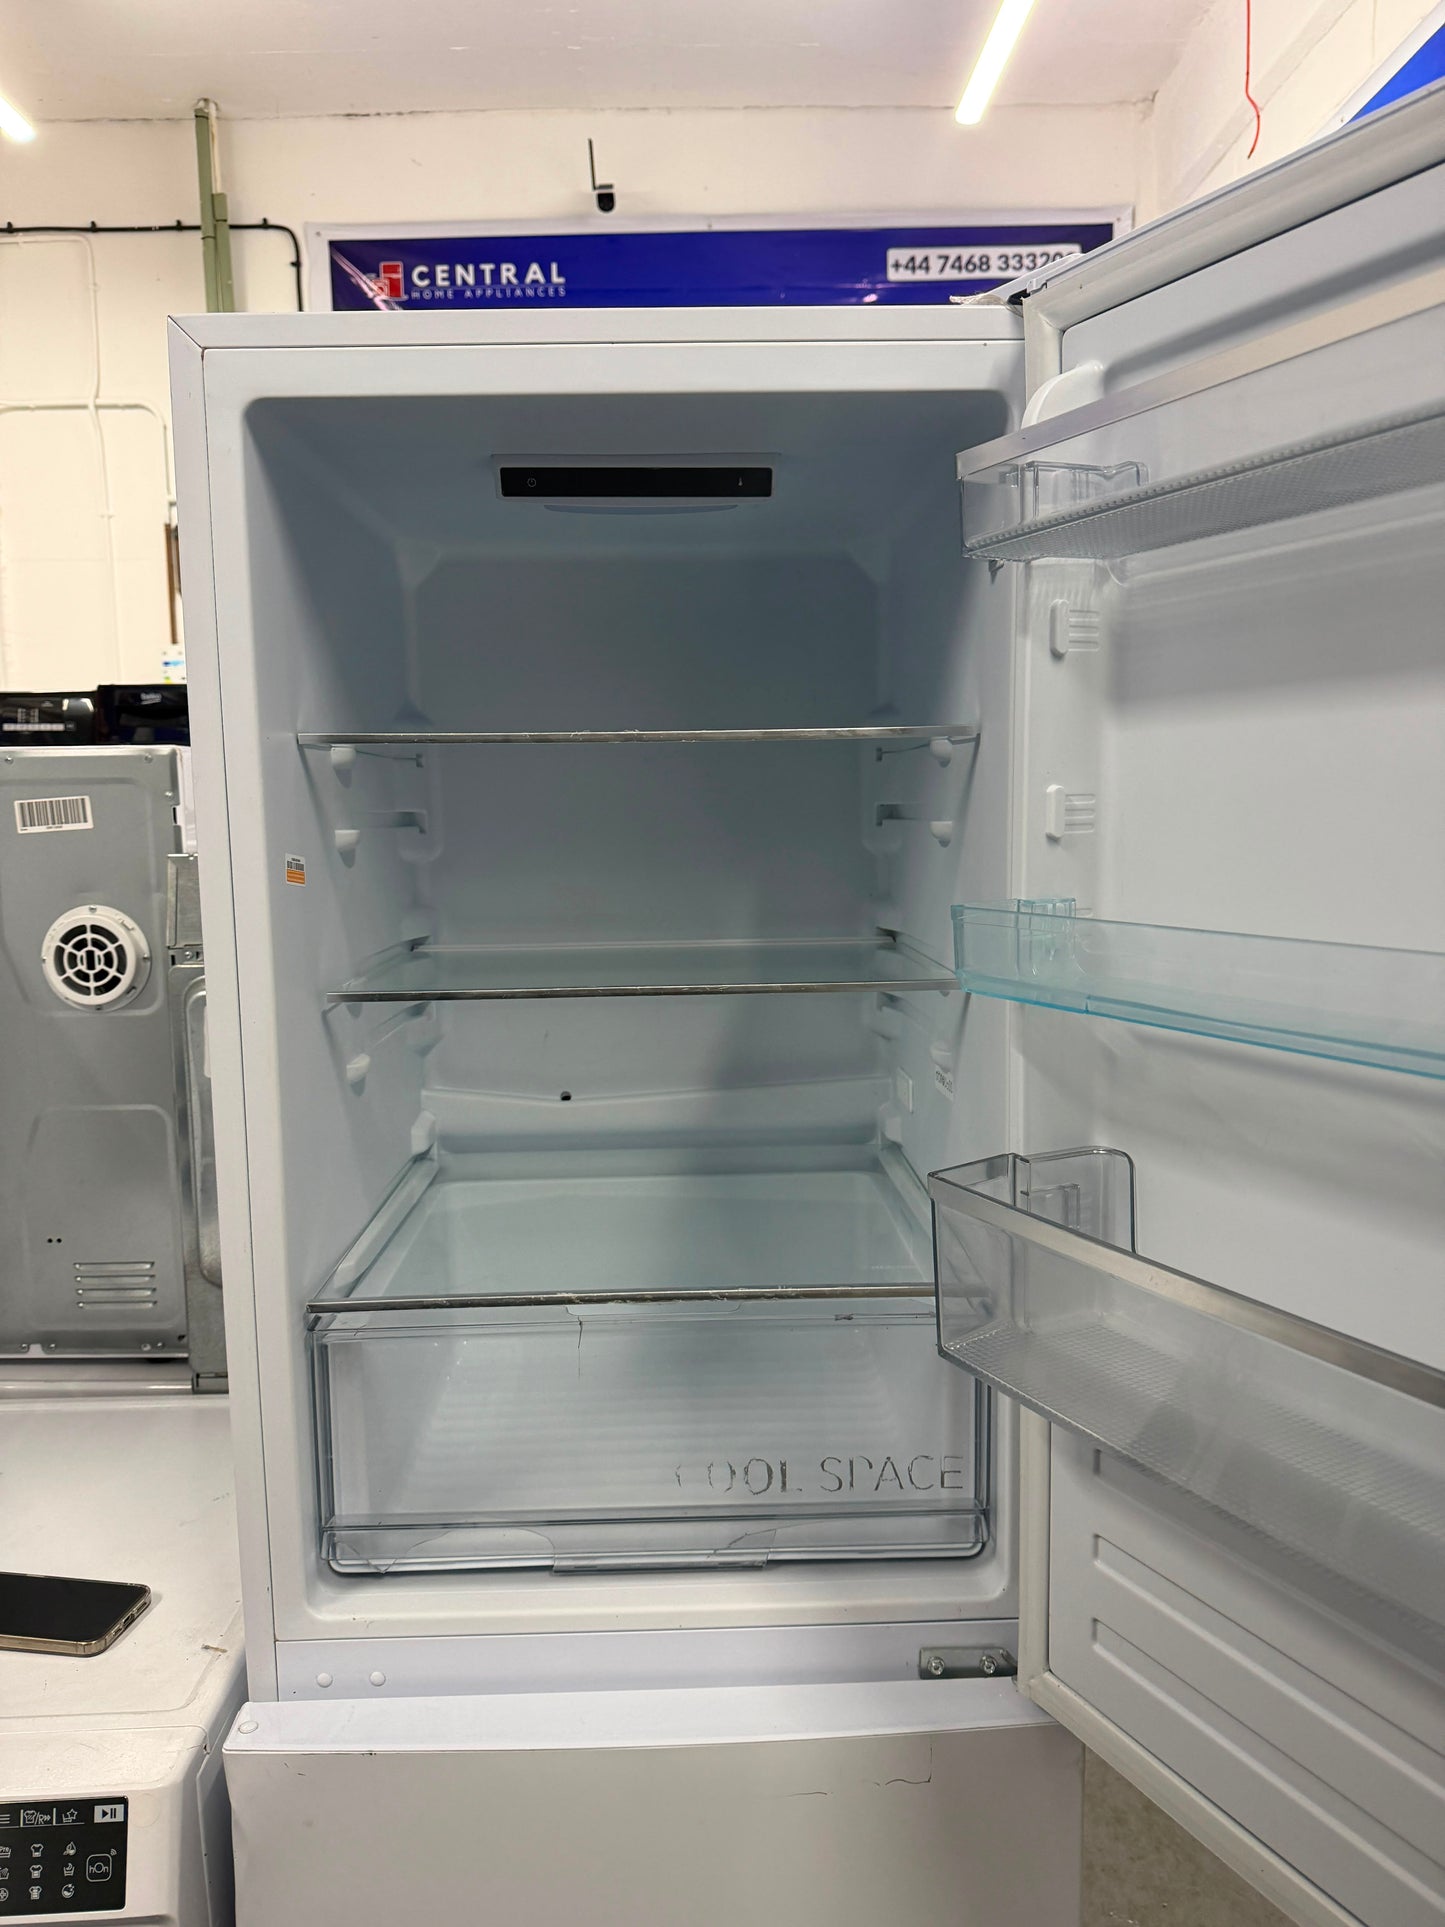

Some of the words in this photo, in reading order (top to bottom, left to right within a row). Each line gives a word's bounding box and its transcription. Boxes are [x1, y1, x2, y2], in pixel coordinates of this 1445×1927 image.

[890, 255, 930, 274] +44
[937, 254, 991, 274] 7468
[997, 252, 1076, 271] 3332
[411, 262, 566, 288] CENTRAL
[411, 288, 454, 299] HOME
[464, 285, 567, 298] APPLIANCES
[819, 1455, 964, 1493] SPACE
[89, 1862, 109, 1874] hOn
